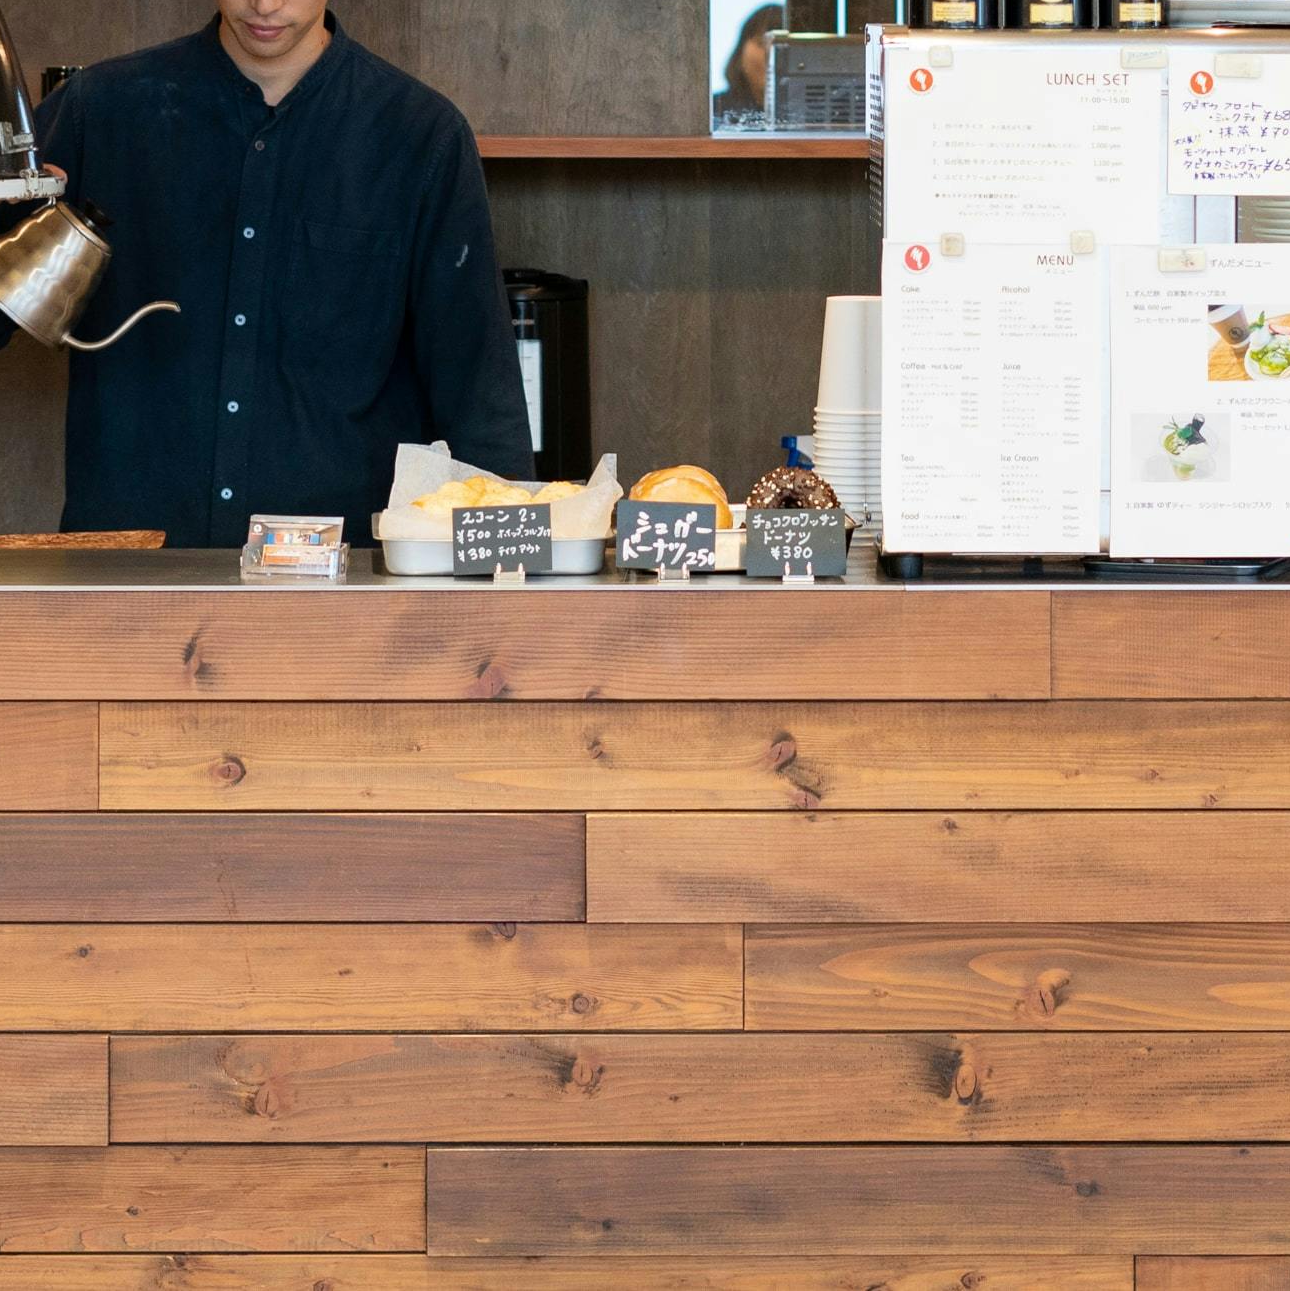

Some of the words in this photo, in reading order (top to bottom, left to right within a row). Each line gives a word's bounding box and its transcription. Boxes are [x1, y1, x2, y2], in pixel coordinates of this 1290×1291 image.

[1046, 73, 1095, 86] LUNCH
[1103, 73, 1130, 86] SET
[1037, 254, 1075, 266] MENU
[901, 285, 921, 294] Cake
[1001, 285, 1031, 294] Alcohol
[901, 361, 926, 370] Coffee
[1003, 362, 1022, 371] Juice
[901, 454, 915, 462] Tea
[1000, 453, 1012, 462] Ice
[1014, 453, 1039, 462] Cream
[462, 510, 510, 525] スコーン
[636, 511, 713, 538] シュガー
[752, 513, 838, 530] チョコクロワッサン
[457, 528, 492, 544] ¥500
[764, 530, 811, 546] ドーナツ
[457, 547, 492, 562] ¥380
[623, 534, 687, 565] ドーナツ
[770, 546, 813, 560] ¥380
[685, 549, 715, 566] 250
